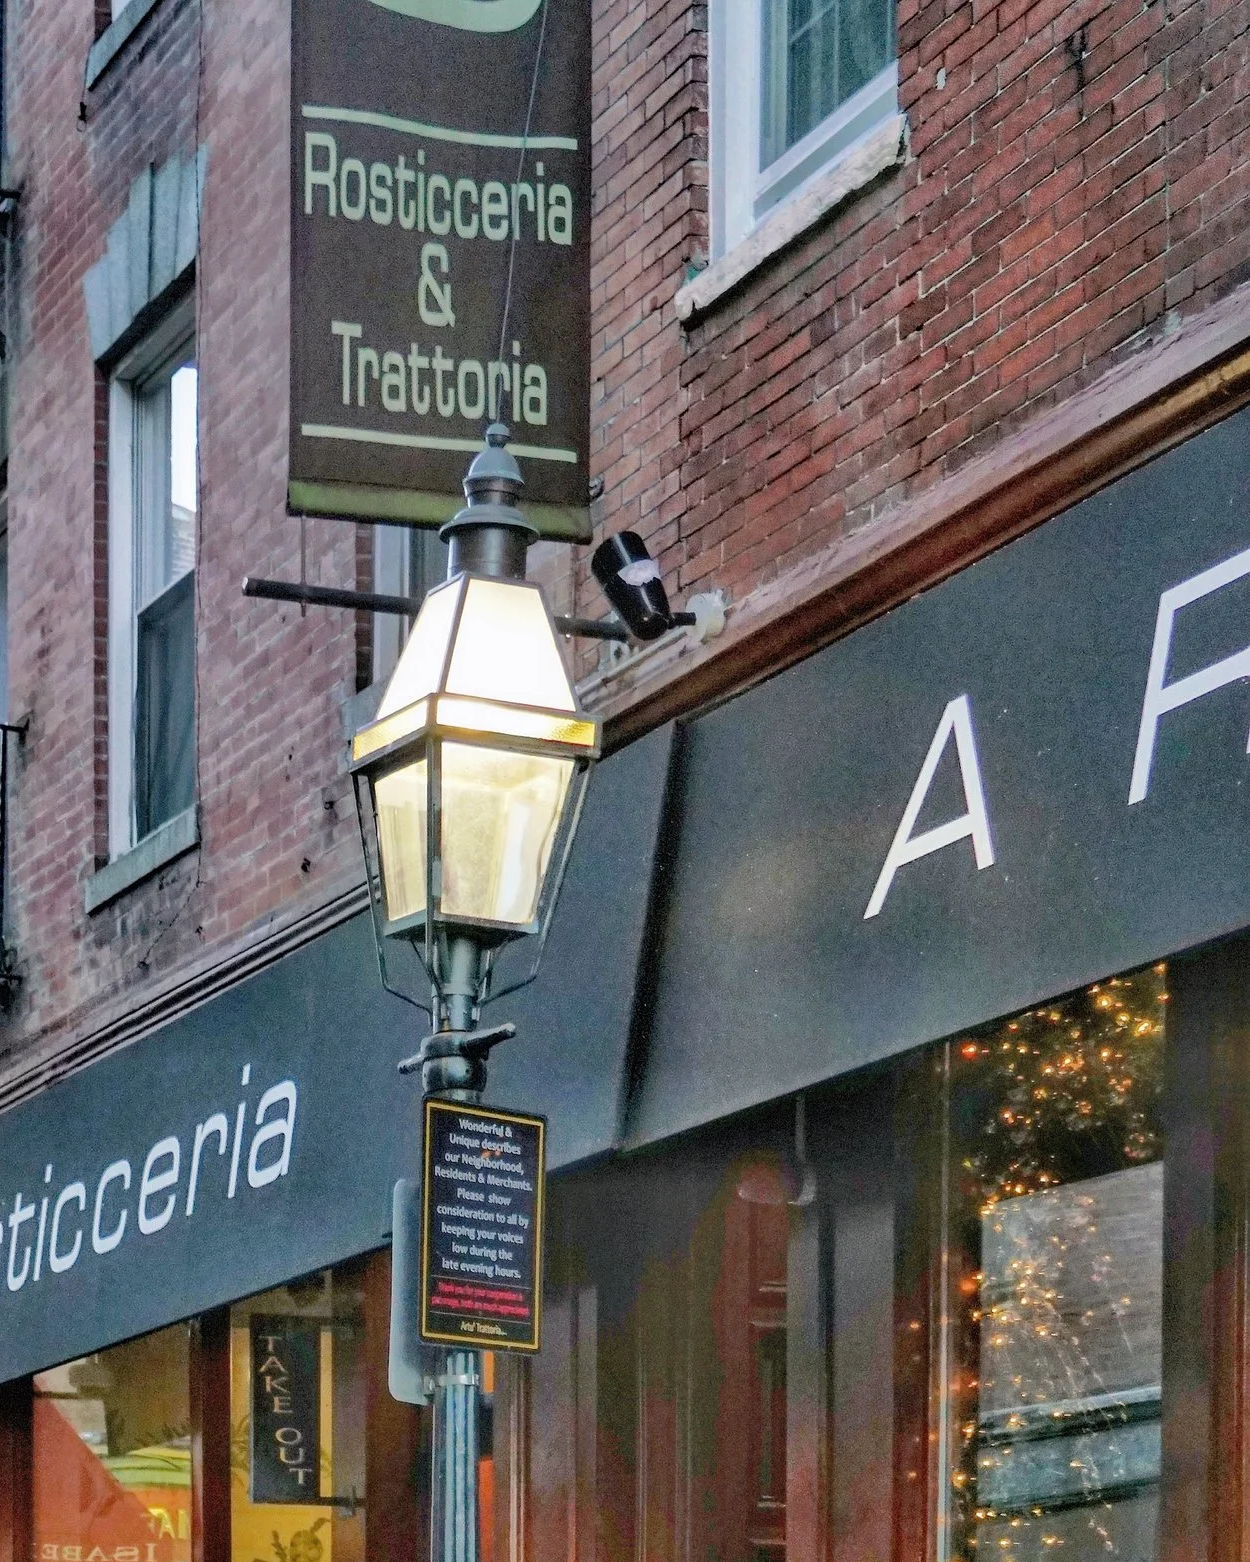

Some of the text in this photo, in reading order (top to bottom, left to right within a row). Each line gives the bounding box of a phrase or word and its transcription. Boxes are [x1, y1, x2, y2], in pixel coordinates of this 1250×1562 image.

[304, 131, 573, 246] Rosticceria
[417, 242, 456, 328] &
[331, 320, 548, 426] Trattoria
[458, 1118, 513, 1138] Wonderful &
[449, 1133, 522, 1155] Unique describes
[444, 1152, 524, 1175] our Neighborhood,
[434, 1165, 533, 1192] Residents & Merchants.
[456, 1187, 512, 1205] Please show
[436, 1204, 529, 1229] consideration to all by
[441, 1221, 524, 1244] keeping your voices
[451, 1241, 513, 1261] low during the
[442, 1257, 522, 1279] late evening hours.
[259, 1336, 314, 1486] TAKE OUT
